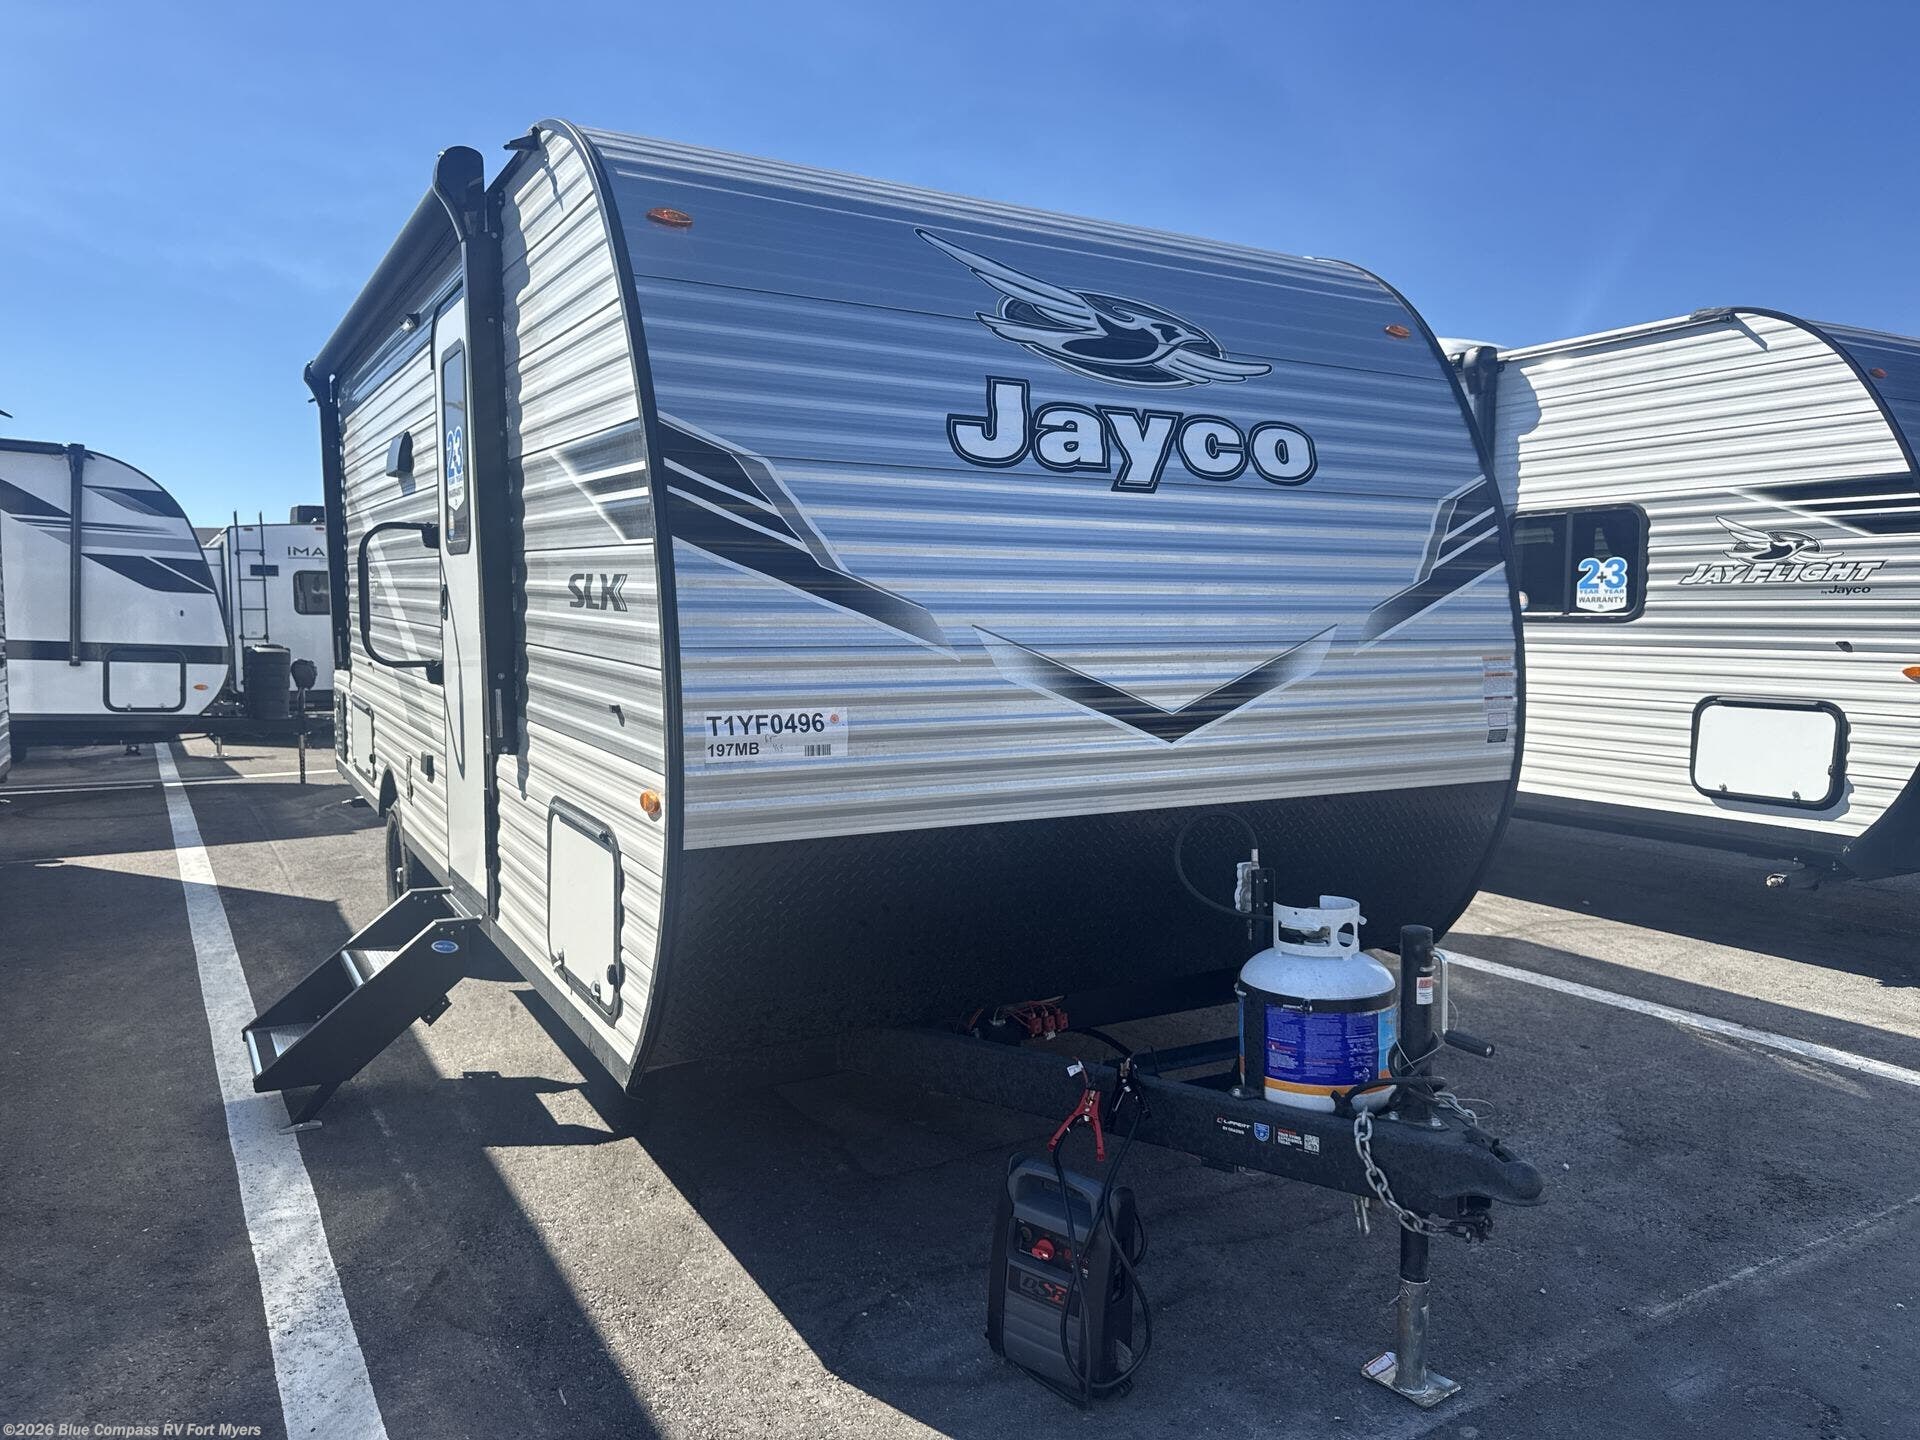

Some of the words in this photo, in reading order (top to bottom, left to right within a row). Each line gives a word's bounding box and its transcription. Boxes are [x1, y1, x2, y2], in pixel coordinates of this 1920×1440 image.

[946, 375, 1318, 493] Jayco
[568, 573, 628, 612] SLK
[1829, 585, 1871, 595] Jayco
[706, 712, 825, 737] T1YF0496
[707, 742, 760, 757] 197MB
